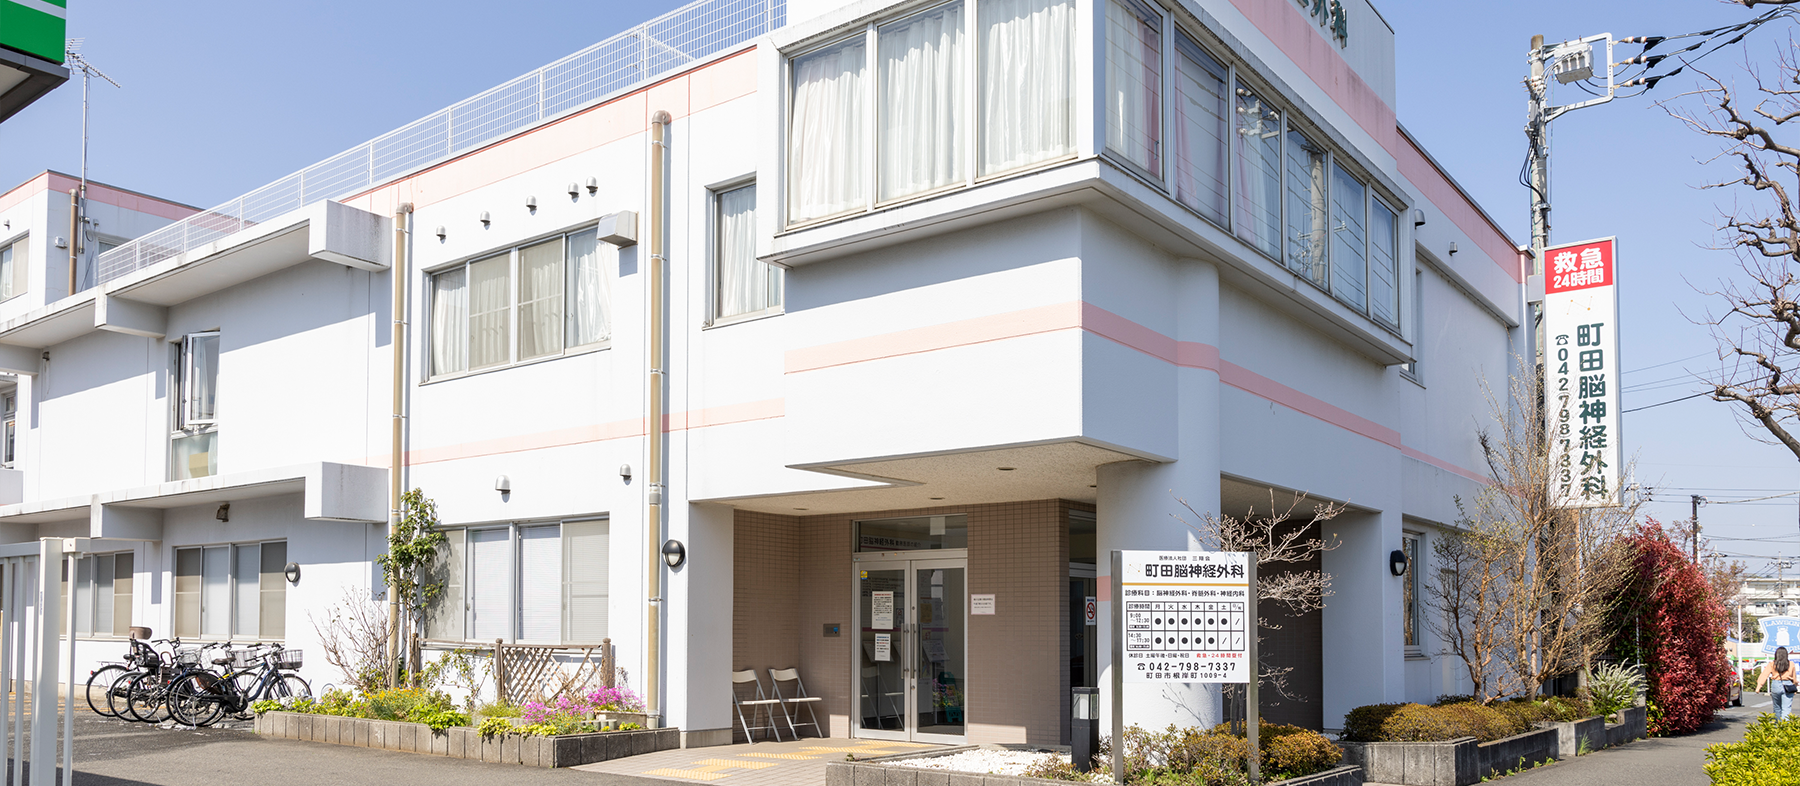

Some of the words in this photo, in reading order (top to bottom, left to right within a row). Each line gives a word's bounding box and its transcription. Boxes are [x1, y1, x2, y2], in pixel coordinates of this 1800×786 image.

[1553, 247, 1604, 274] 救急
[1553, 267, 1604, 289] 24時間
[1576, 322, 1609, 501] 町田脳神経外科
[1145, 563, 1245, 579] 町田脳神経外科
[1148, 662, 1237, 671] 042-798-7337
